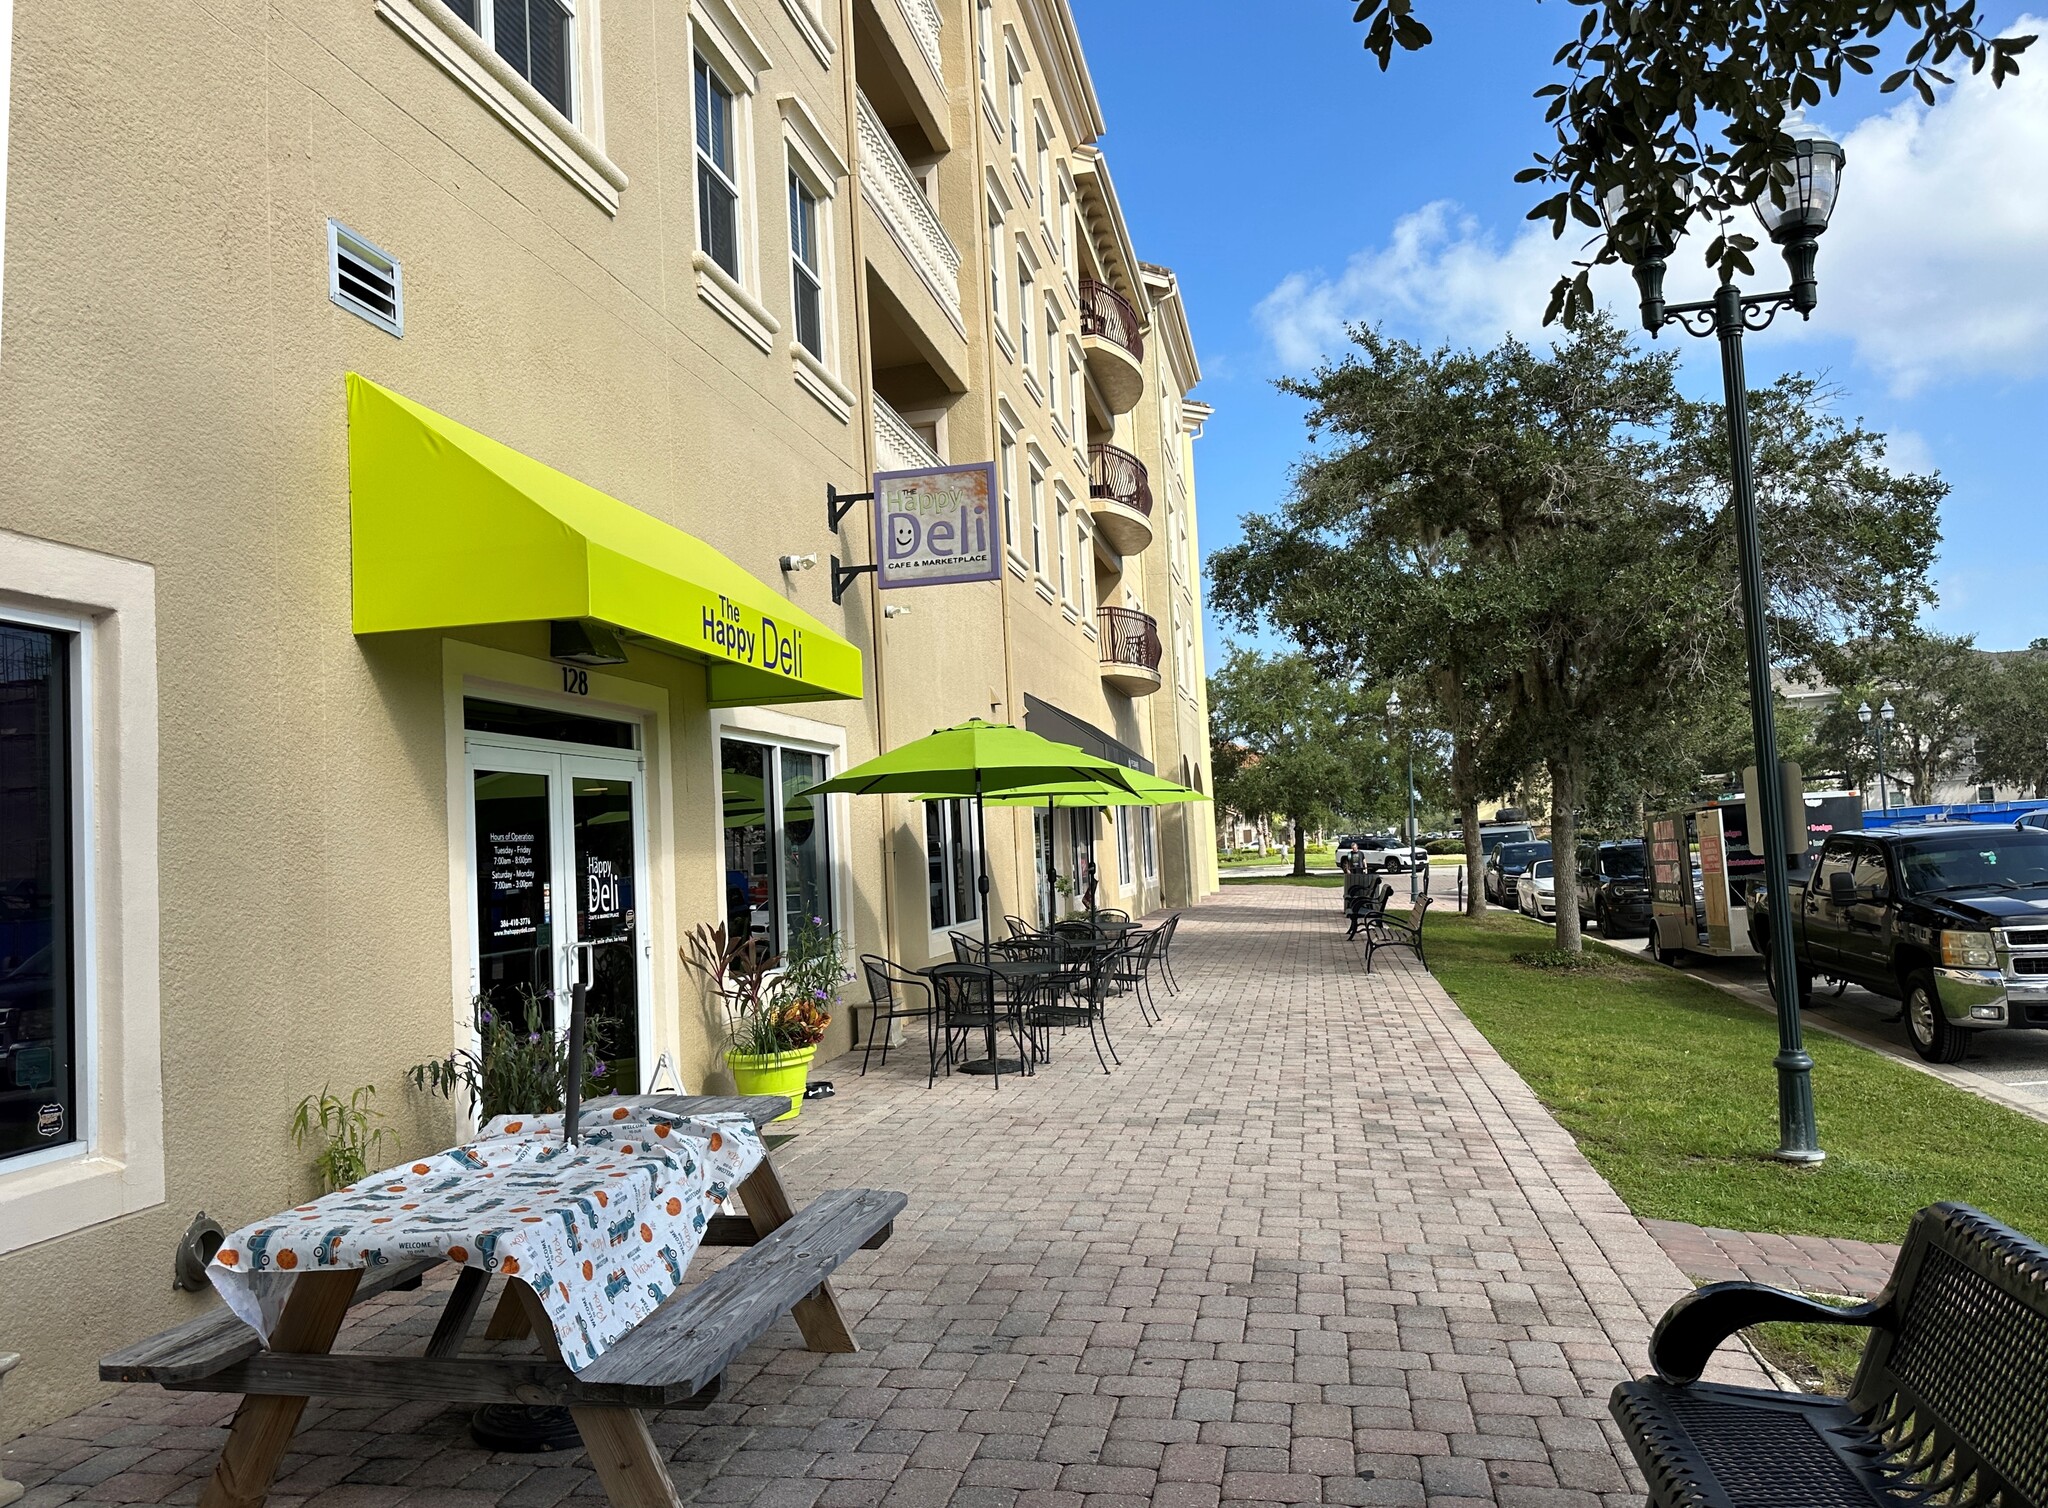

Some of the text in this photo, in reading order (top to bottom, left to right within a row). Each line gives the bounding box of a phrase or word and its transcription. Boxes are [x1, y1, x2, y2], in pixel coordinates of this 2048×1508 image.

[887, 489, 963, 515] Happy
[902, 488, 917, 496] THE
[888, 505, 986, 560] Deli
[888, 561, 911, 570] CAFE
[922, 555, 987, 566] MARKETPLACE
[719, 595, 740, 623] The
[702, 606, 803, 678] Happy Deli
[562, 667, 588, 696] 128
[490, 832, 534, 842] Hours of Operation
[494, 845, 513, 856] Tuesday
[517, 845, 531, 855] Friday
[494, 856, 511, 865] 7:00am
[492, 870, 513, 880] Saturday
[516, 869, 535, 878] Monday
[588, 856, 612, 878] Happy
[494, 881, 512, 889] 7:00am
[589, 874, 619, 913] Deli
[541, 1239, 553, 1271] WELCOME
[582, 1297, 596, 1328] WELCOME
